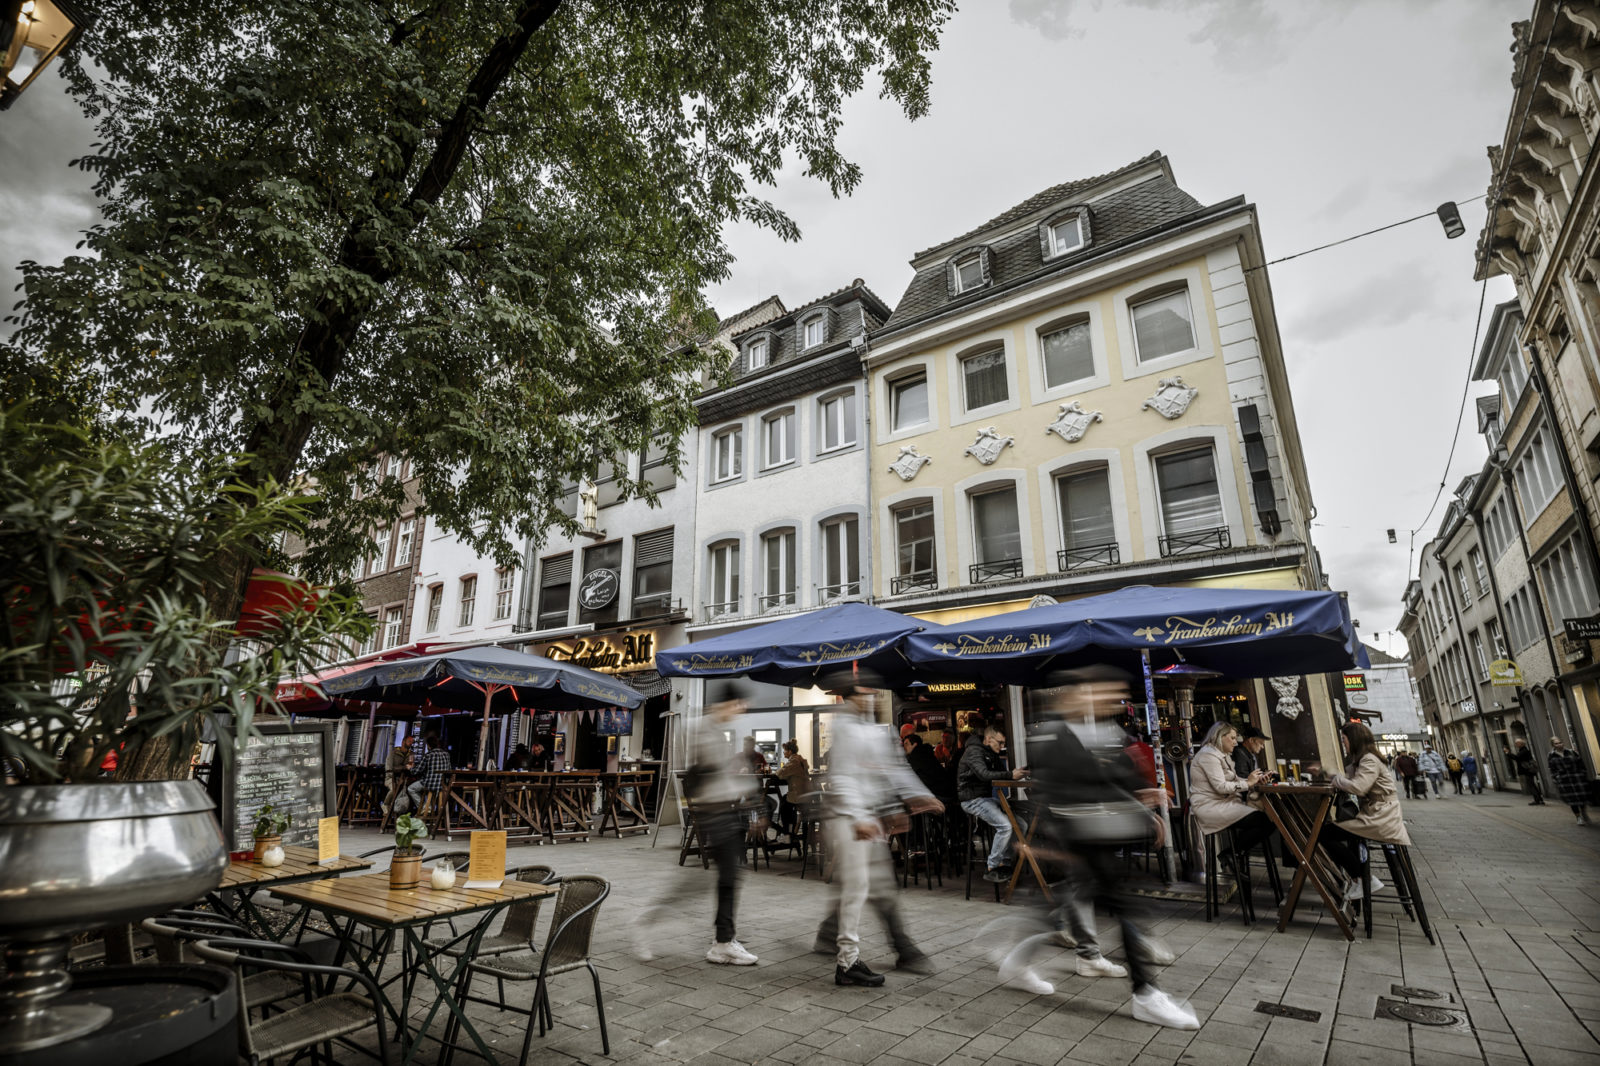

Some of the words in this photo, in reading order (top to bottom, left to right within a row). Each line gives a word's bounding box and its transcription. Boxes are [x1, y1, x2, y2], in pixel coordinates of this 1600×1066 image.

[589, 570, 607, 581] ENGEL
[1164, 615, 1263, 644] Frankenheim
[1264, 612, 1296, 632] Alt
[621, 633, 653, 668] Alt
[817, 641, 875, 664] Frankenheim
[955, 634, 1028, 656] Frankenheim
[1029, 633, 1052, 650] Alt
[687, 653, 738, 671] Frankenheim
[738, 654, 753, 668] Alt
[928, 683, 976, 692] WARSTEINER
